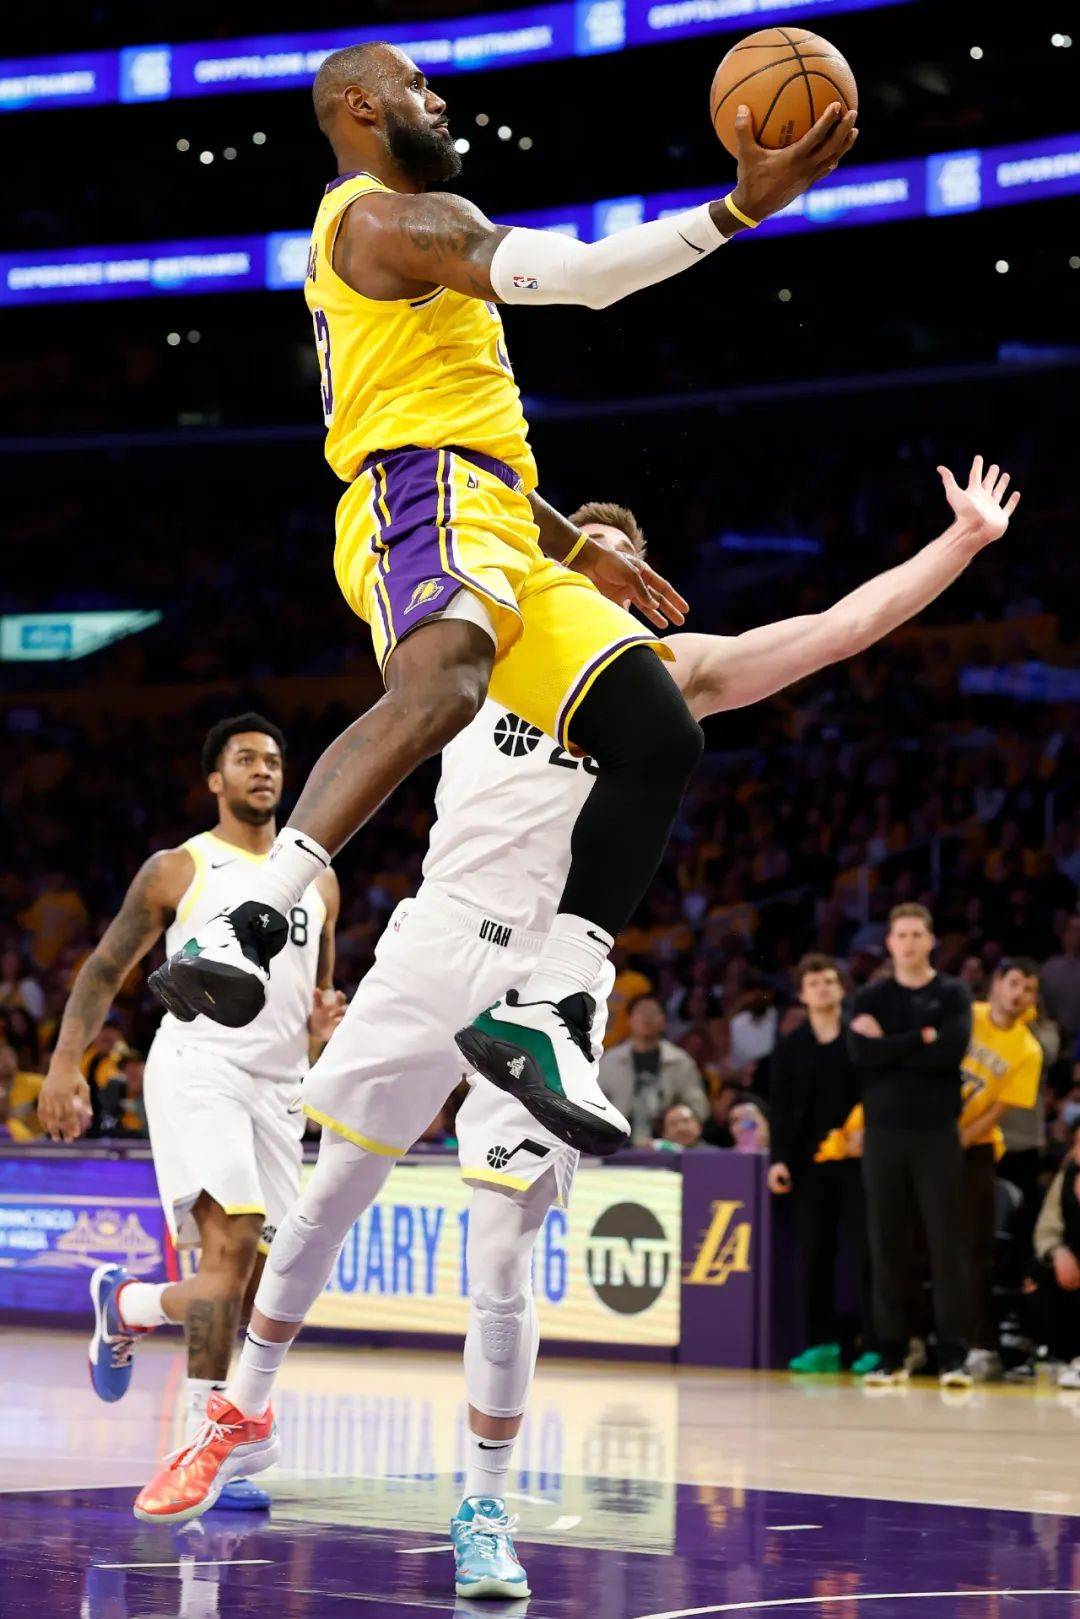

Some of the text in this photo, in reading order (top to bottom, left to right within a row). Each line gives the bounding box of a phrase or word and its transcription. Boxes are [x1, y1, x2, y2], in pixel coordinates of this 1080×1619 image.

[479, 919, 512, 947] UTAH
[326, 1204, 444, 1295] UARY
[587, 1236, 671, 1288] TNT
[683, 1200, 752, 1285] LA
